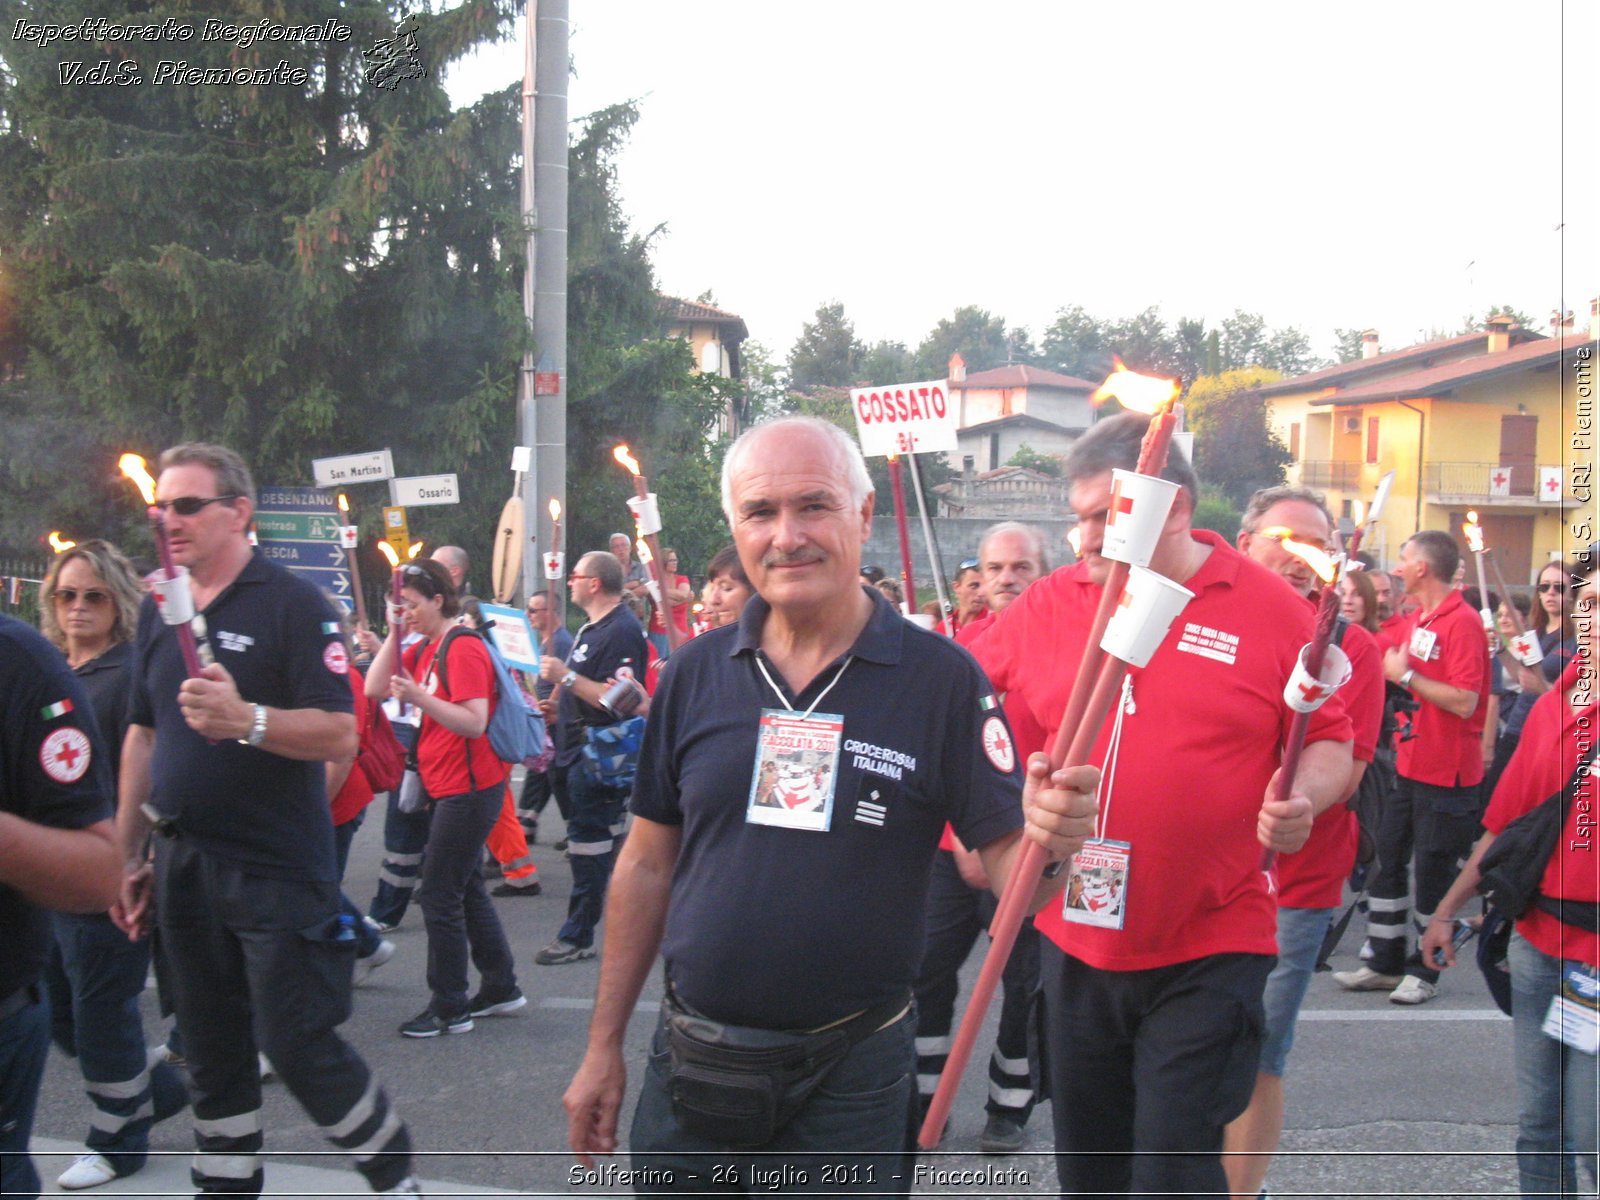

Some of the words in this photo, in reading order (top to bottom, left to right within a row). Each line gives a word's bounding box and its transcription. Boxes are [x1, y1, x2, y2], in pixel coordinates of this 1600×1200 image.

[858, 386, 946, 425] COSSATO
[330, 470, 346, 480] San
[350, 465, 382, 477] Martino
[262, 493, 334, 506] DESENZANO
[418, 487, 452, 498] Ossario
[264, 547, 299, 559] ESCIA
[853, 755, 903, 780] ITALIANA
